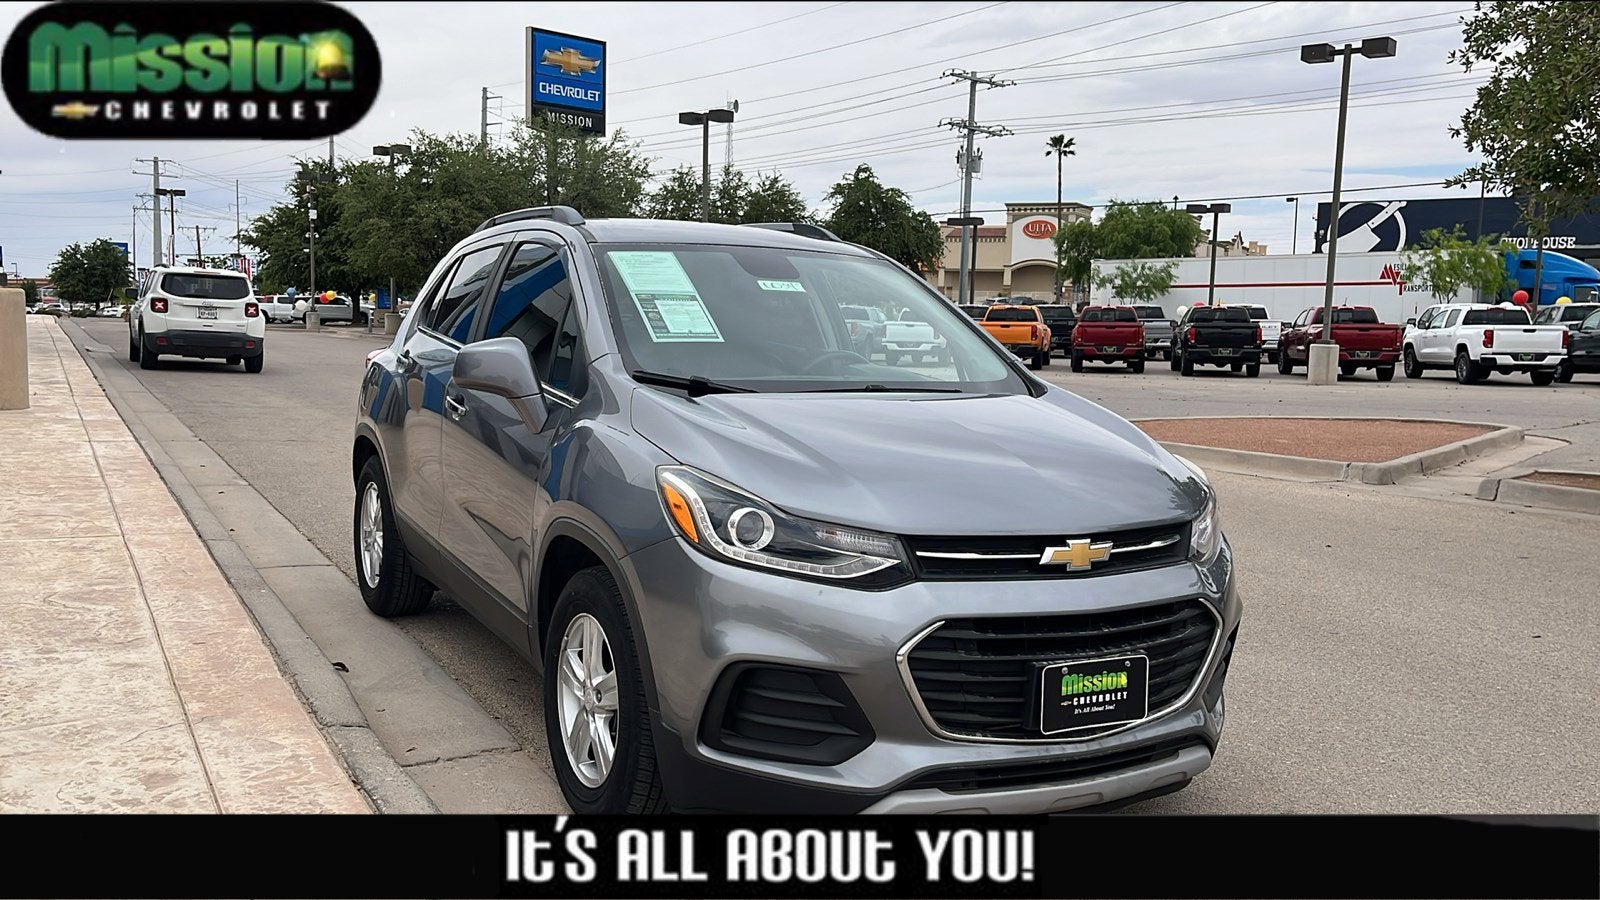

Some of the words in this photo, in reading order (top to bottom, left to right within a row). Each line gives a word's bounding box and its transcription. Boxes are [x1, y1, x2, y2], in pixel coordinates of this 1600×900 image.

[539, 82, 601, 101] CHEVROLET
[547, 112, 592, 128] MISSION
[1061, 670, 1128, 696] Mission
[1073, 691, 1128, 706] CHEVROLET
